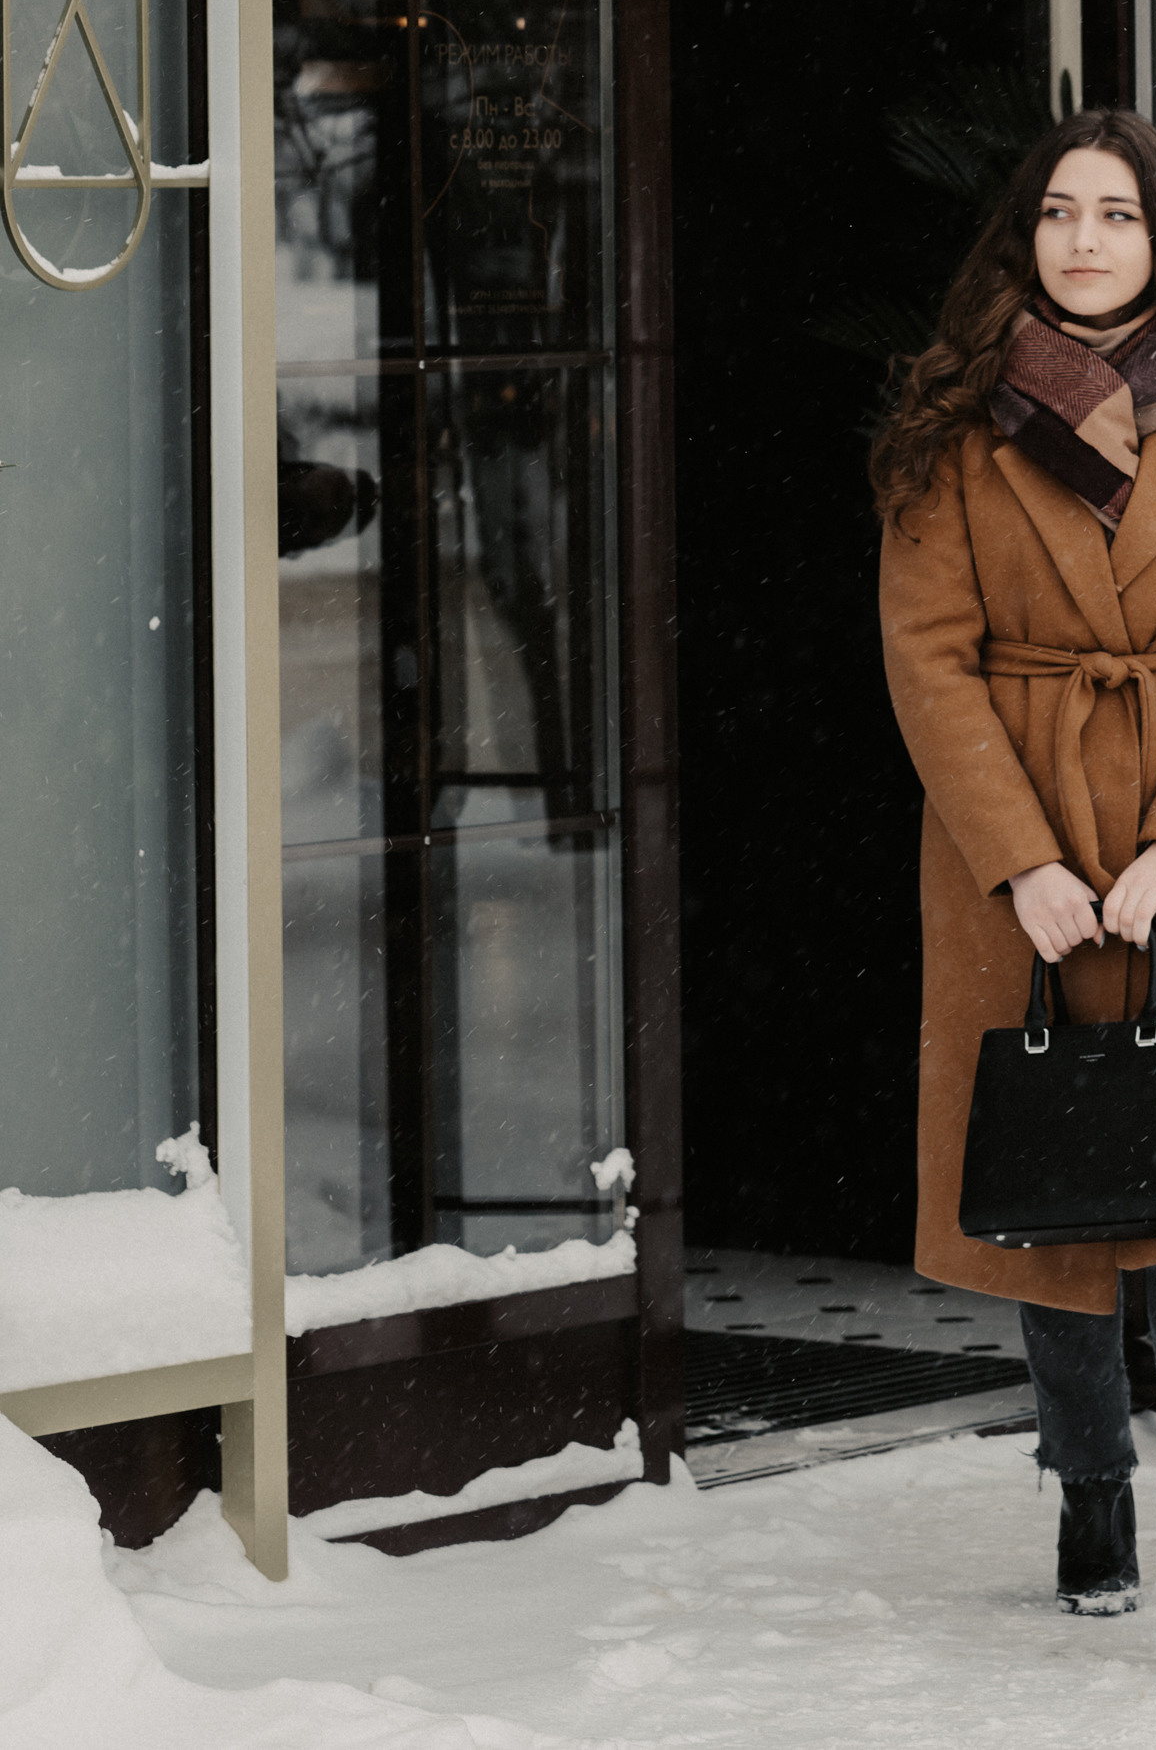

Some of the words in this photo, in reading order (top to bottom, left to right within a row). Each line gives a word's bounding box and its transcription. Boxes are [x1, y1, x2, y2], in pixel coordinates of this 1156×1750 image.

[438, 42, 501, 66] РЕЖИМ
[504, 42, 572, 66] РАБОТЫ
[475, 95, 498, 117] Пн
[514, 95, 536, 117] Вс
[449, 134, 458, 149] с
[463, 127, 494, 149] 8.00
[498, 134, 518, 152] до
[522, 127, 562, 149] 23.00
